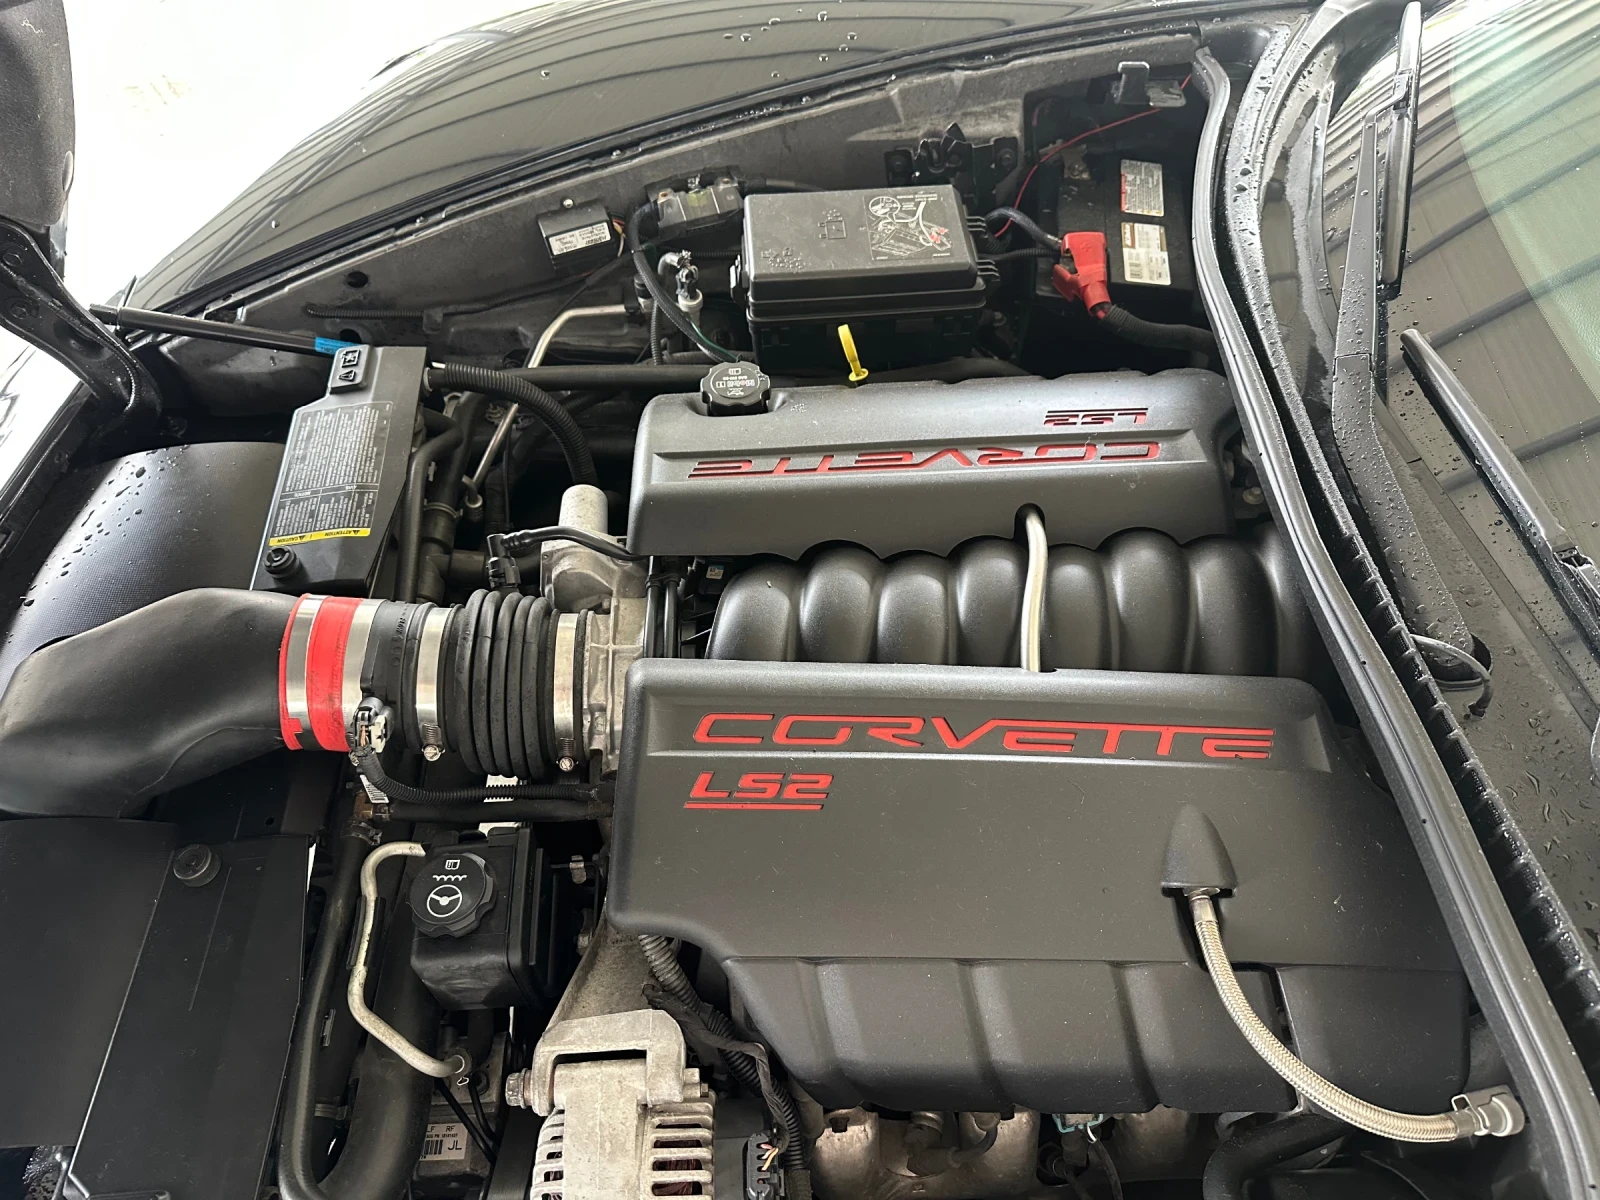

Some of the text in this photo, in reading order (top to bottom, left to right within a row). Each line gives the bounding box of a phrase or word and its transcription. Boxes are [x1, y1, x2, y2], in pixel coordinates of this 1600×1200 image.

[1044, 408, 1148, 426] LS2
[688, 441, 1161, 479] CORVETTE
[693, 713, 1277, 760] CORVETTE
[689, 772, 834, 800] LS2
[448, 1140, 462, 1150] JL
